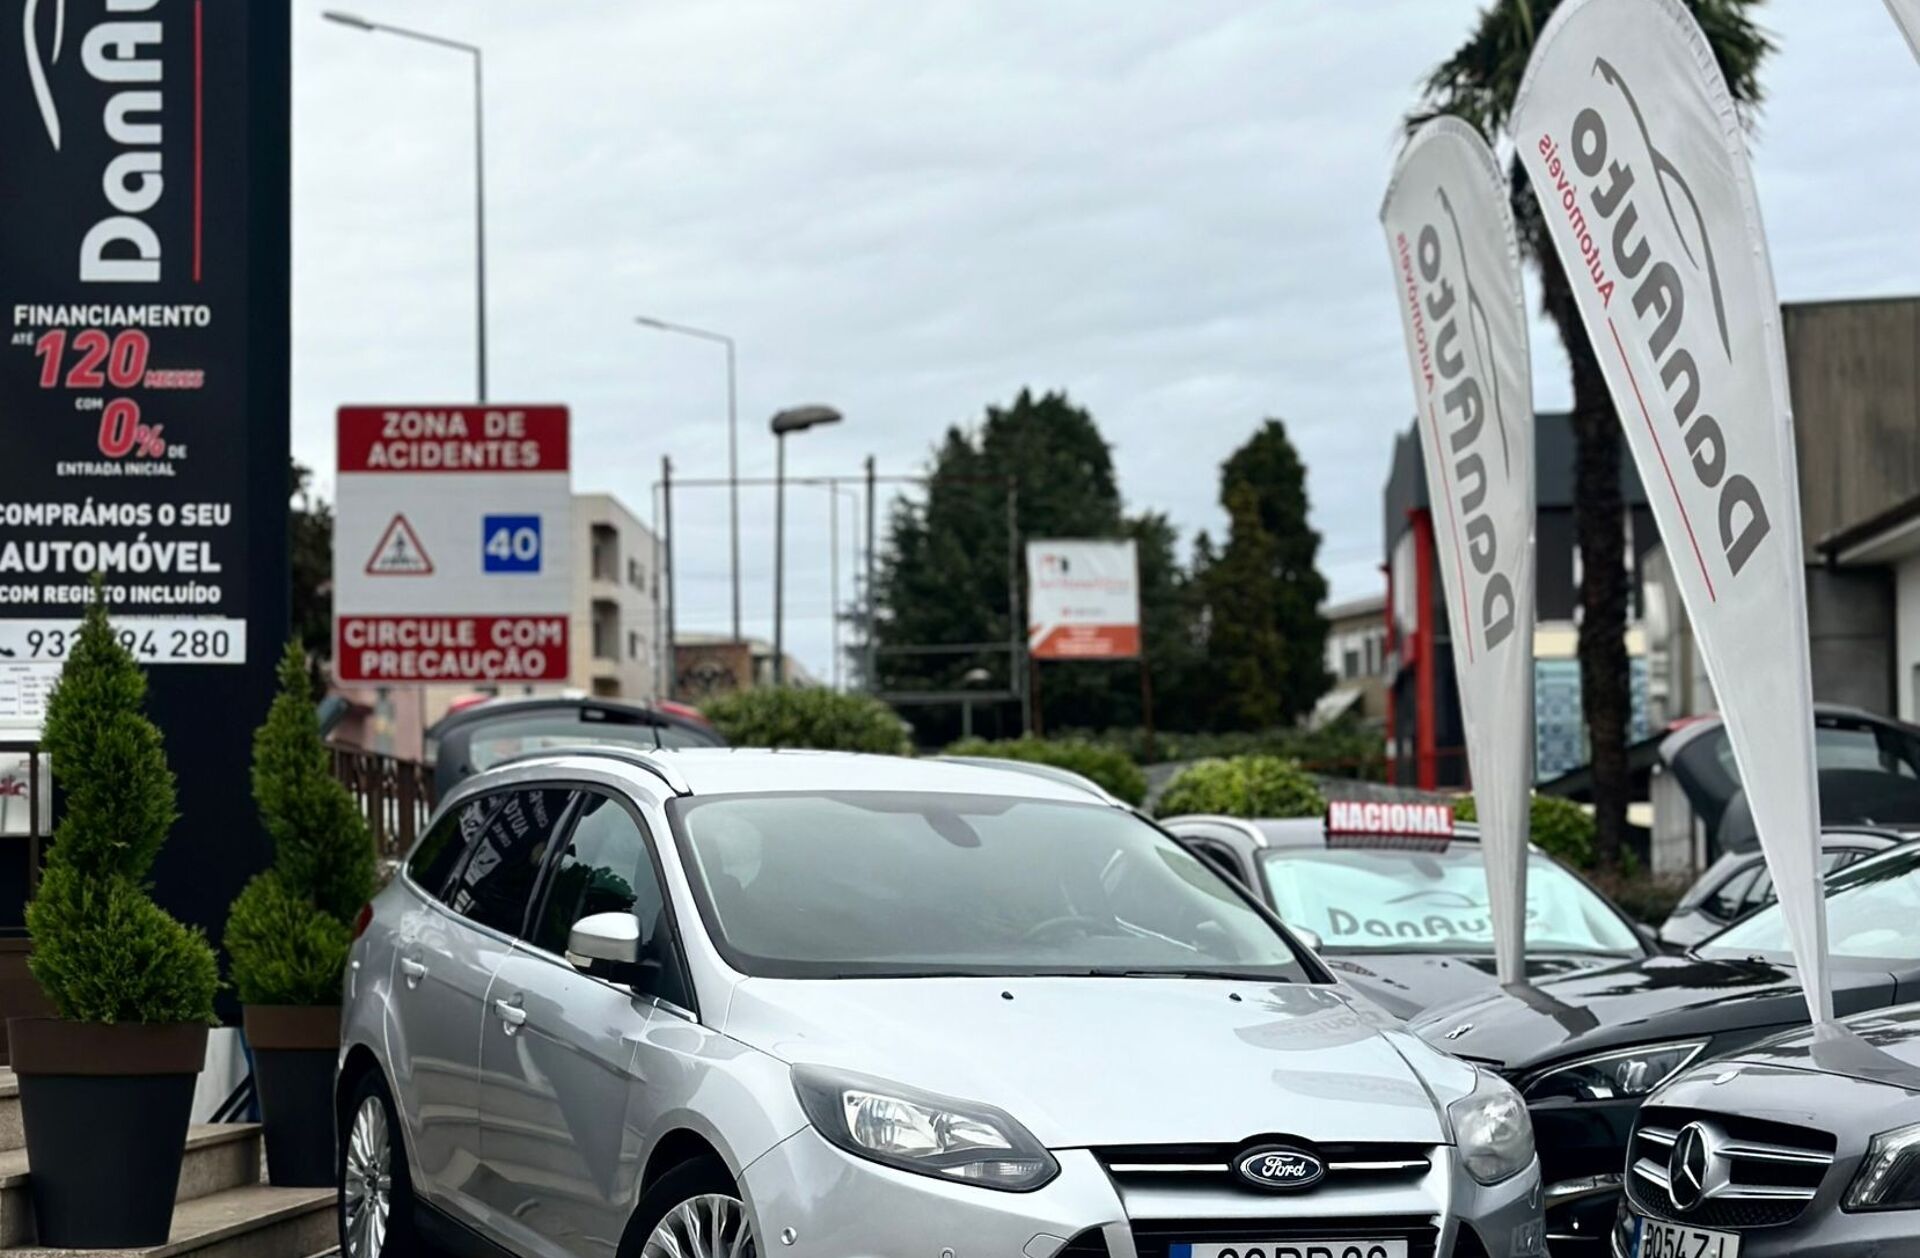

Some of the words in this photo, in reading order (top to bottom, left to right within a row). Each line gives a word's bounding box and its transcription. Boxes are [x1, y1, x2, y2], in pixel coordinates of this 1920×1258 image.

[80, 0, 163, 282] DanA
[14, 305, 211, 327] FINANCIAMENTO
[35, 329, 150, 388] 120
[75, 398, 103, 410] COM
[168, 445, 187, 459] DE
[382, 412, 468, 437] ZONA
[484, 412, 526, 437] DE
[367, 441, 540, 468] ACIDENTES
[57, 462, 122, 476] ENTRADA
[124, 462, 176, 476] INICIAL
[158, 503, 176, 526] O
[181, 503, 231, 526] SEU
[0, 532, 222, 573] AUTOMÓVEL
[486, 527, 539, 561] 40
[0, 584, 39, 604] COM
[130, 581, 222, 604] INCLUÍDO
[170, 630, 229, 658] 280
[344, 620, 476, 647] CIRCULE
[491, 620, 562, 647] COM
[361, 647, 546, 681] PRECAUÇÃO
[1329, 802, 1452, 834] NACIONAL
[1262, 1155, 1306, 1178] Ford
